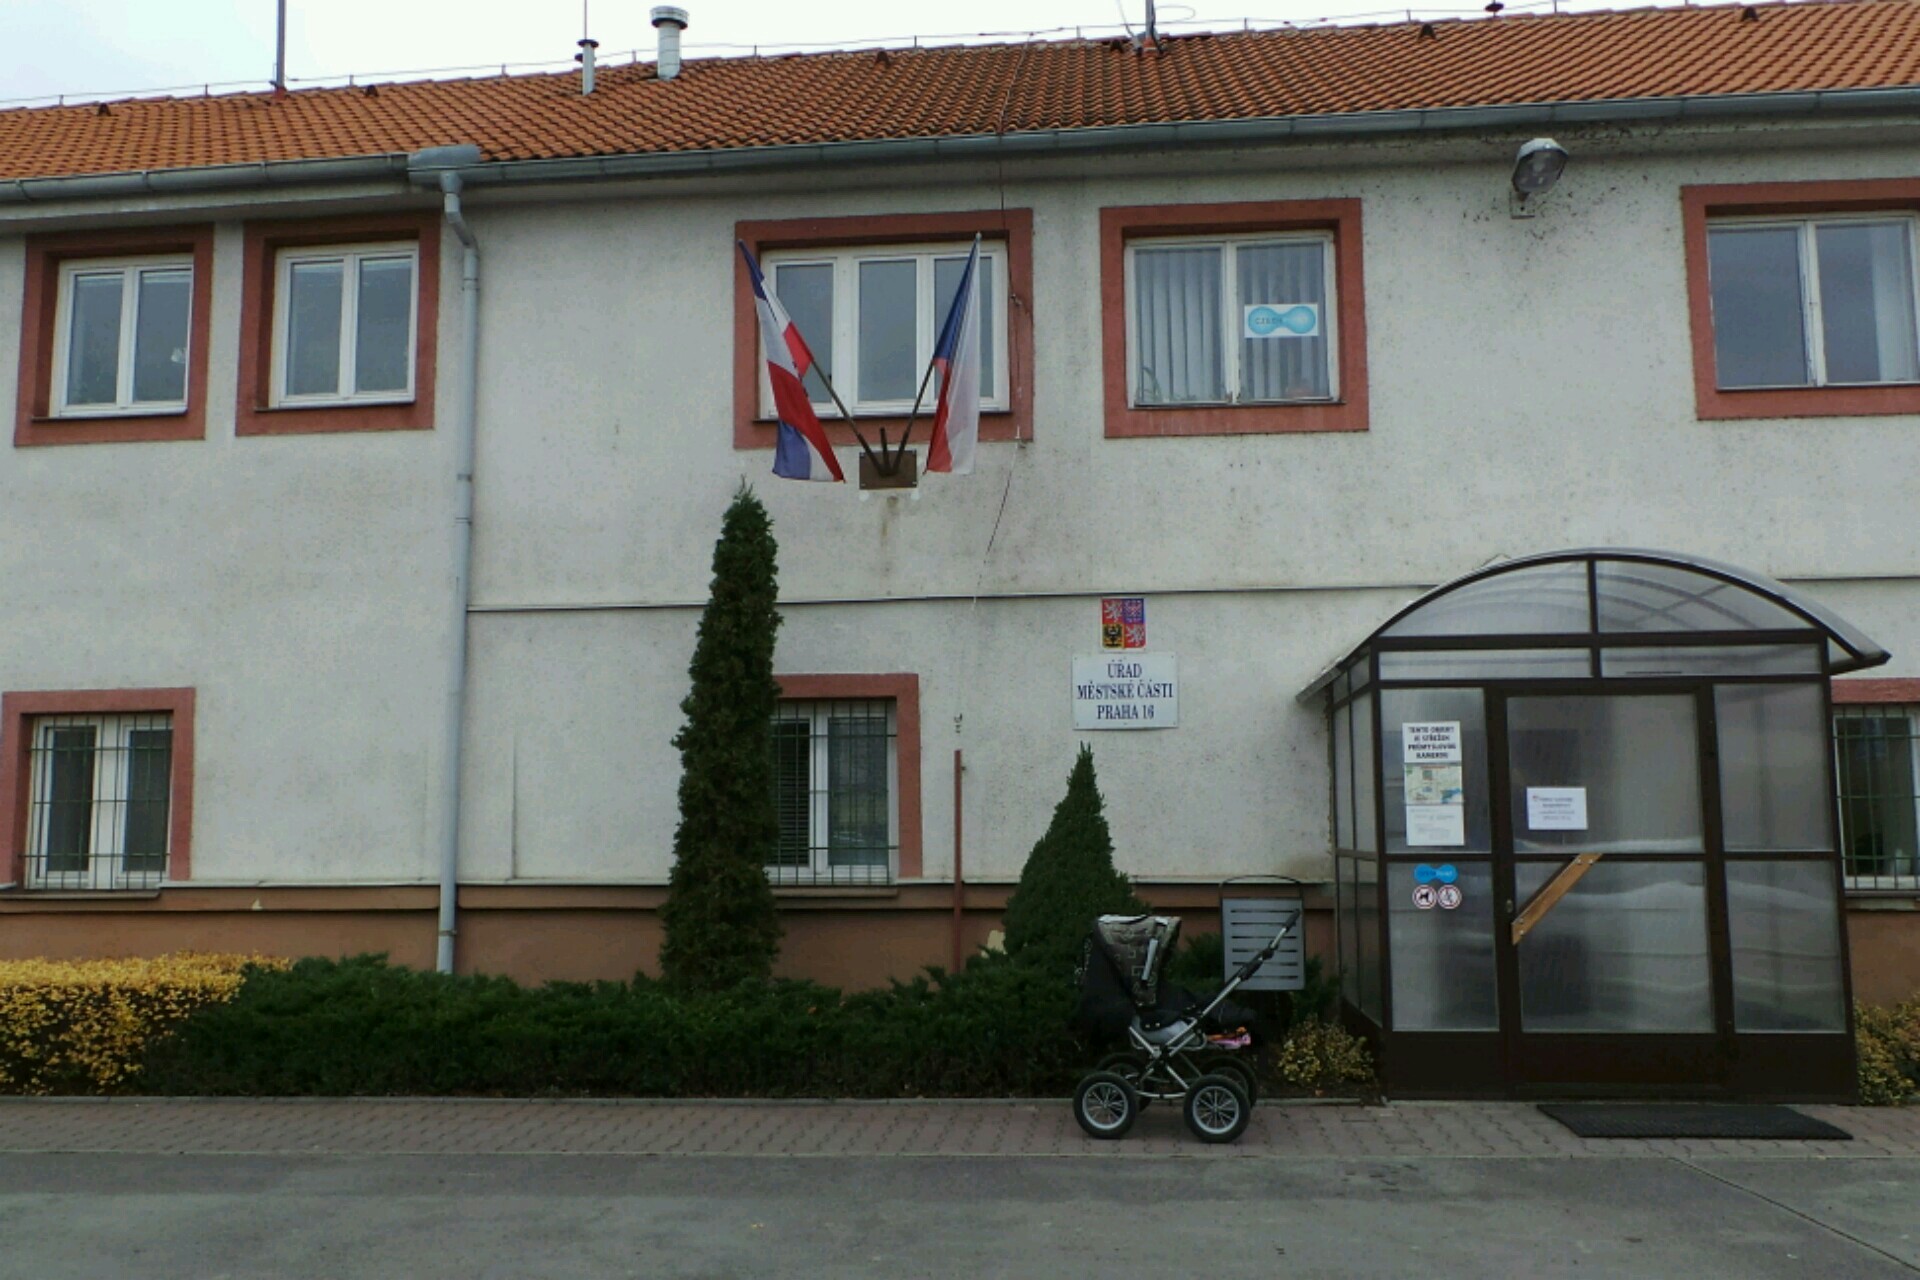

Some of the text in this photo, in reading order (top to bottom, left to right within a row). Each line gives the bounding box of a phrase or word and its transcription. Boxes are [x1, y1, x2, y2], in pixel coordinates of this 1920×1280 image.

[1107, 659, 1142, 678] ÚŘAD
[1077, 678, 1173, 700] MĚSTSKÉ ČÁSTI
[1097, 704, 1154, 719] PRAHA 16
